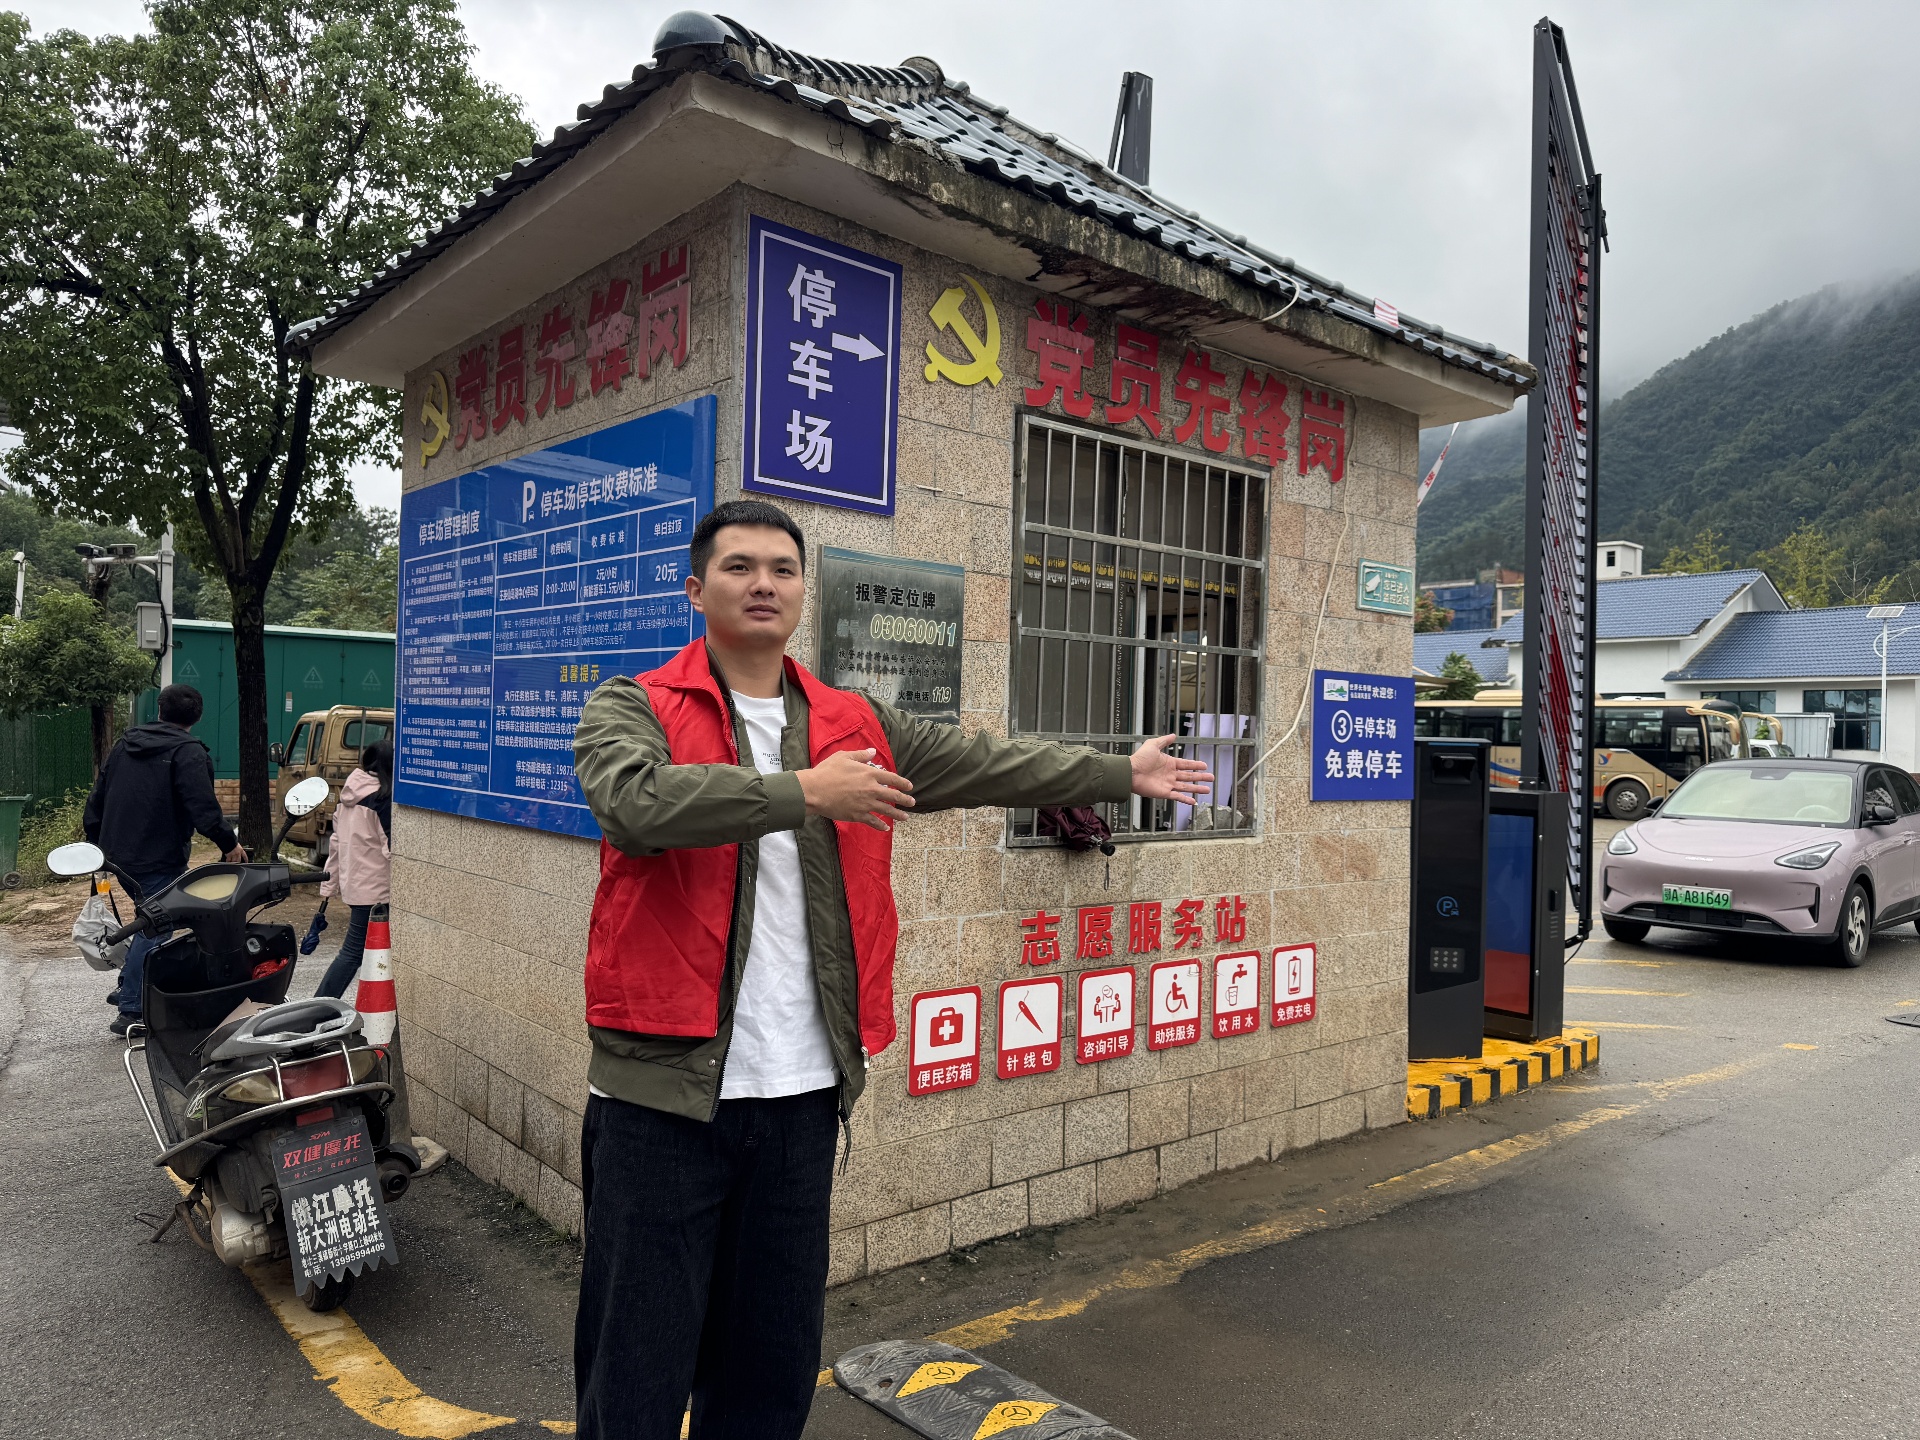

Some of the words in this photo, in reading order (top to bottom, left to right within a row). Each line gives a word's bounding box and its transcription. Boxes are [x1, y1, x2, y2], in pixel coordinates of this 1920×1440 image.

[455, 243, 691, 450] 党员先锋岗
[785, 263, 837, 473] 停车场
[1023, 298, 1346, 483] 党员先锋岗
[541, 462, 658, 518] 停车场停车收费标准
[418, 510, 481, 546] 停车场管理制度
[653, 519, 682, 536] 单日封顶
[503, 547, 538, 564] 停车场管理制度
[550, 541, 572, 556] 收费时间
[654, 561, 679, 582] 20元
[545, 580, 577, 595] 8:00-20:00
[855, 582, 936, 609] 报警定位牌
[870, 613, 957, 647] 03060011
[559, 664, 600, 683] 温馨提示
[1324, 748, 1403, 779] 免费停车
[1019, 894, 1247, 966] 志愿服务站
[1218, 1013, 1255, 1033] 饮用水
[1276, 1002, 1313, 1023] 免费充电
[1083, 1034, 1130, 1059] 咨询引导
[1154, 1023, 1197, 1045] 助残服务
[1006, 1049, 1053, 1072] 针线包
[917, 1061, 973, 1090] 便民药箱
[282, 1132, 362, 1169] 双健摩托
[296, 1205, 380, 1256] 新大洲电动车
